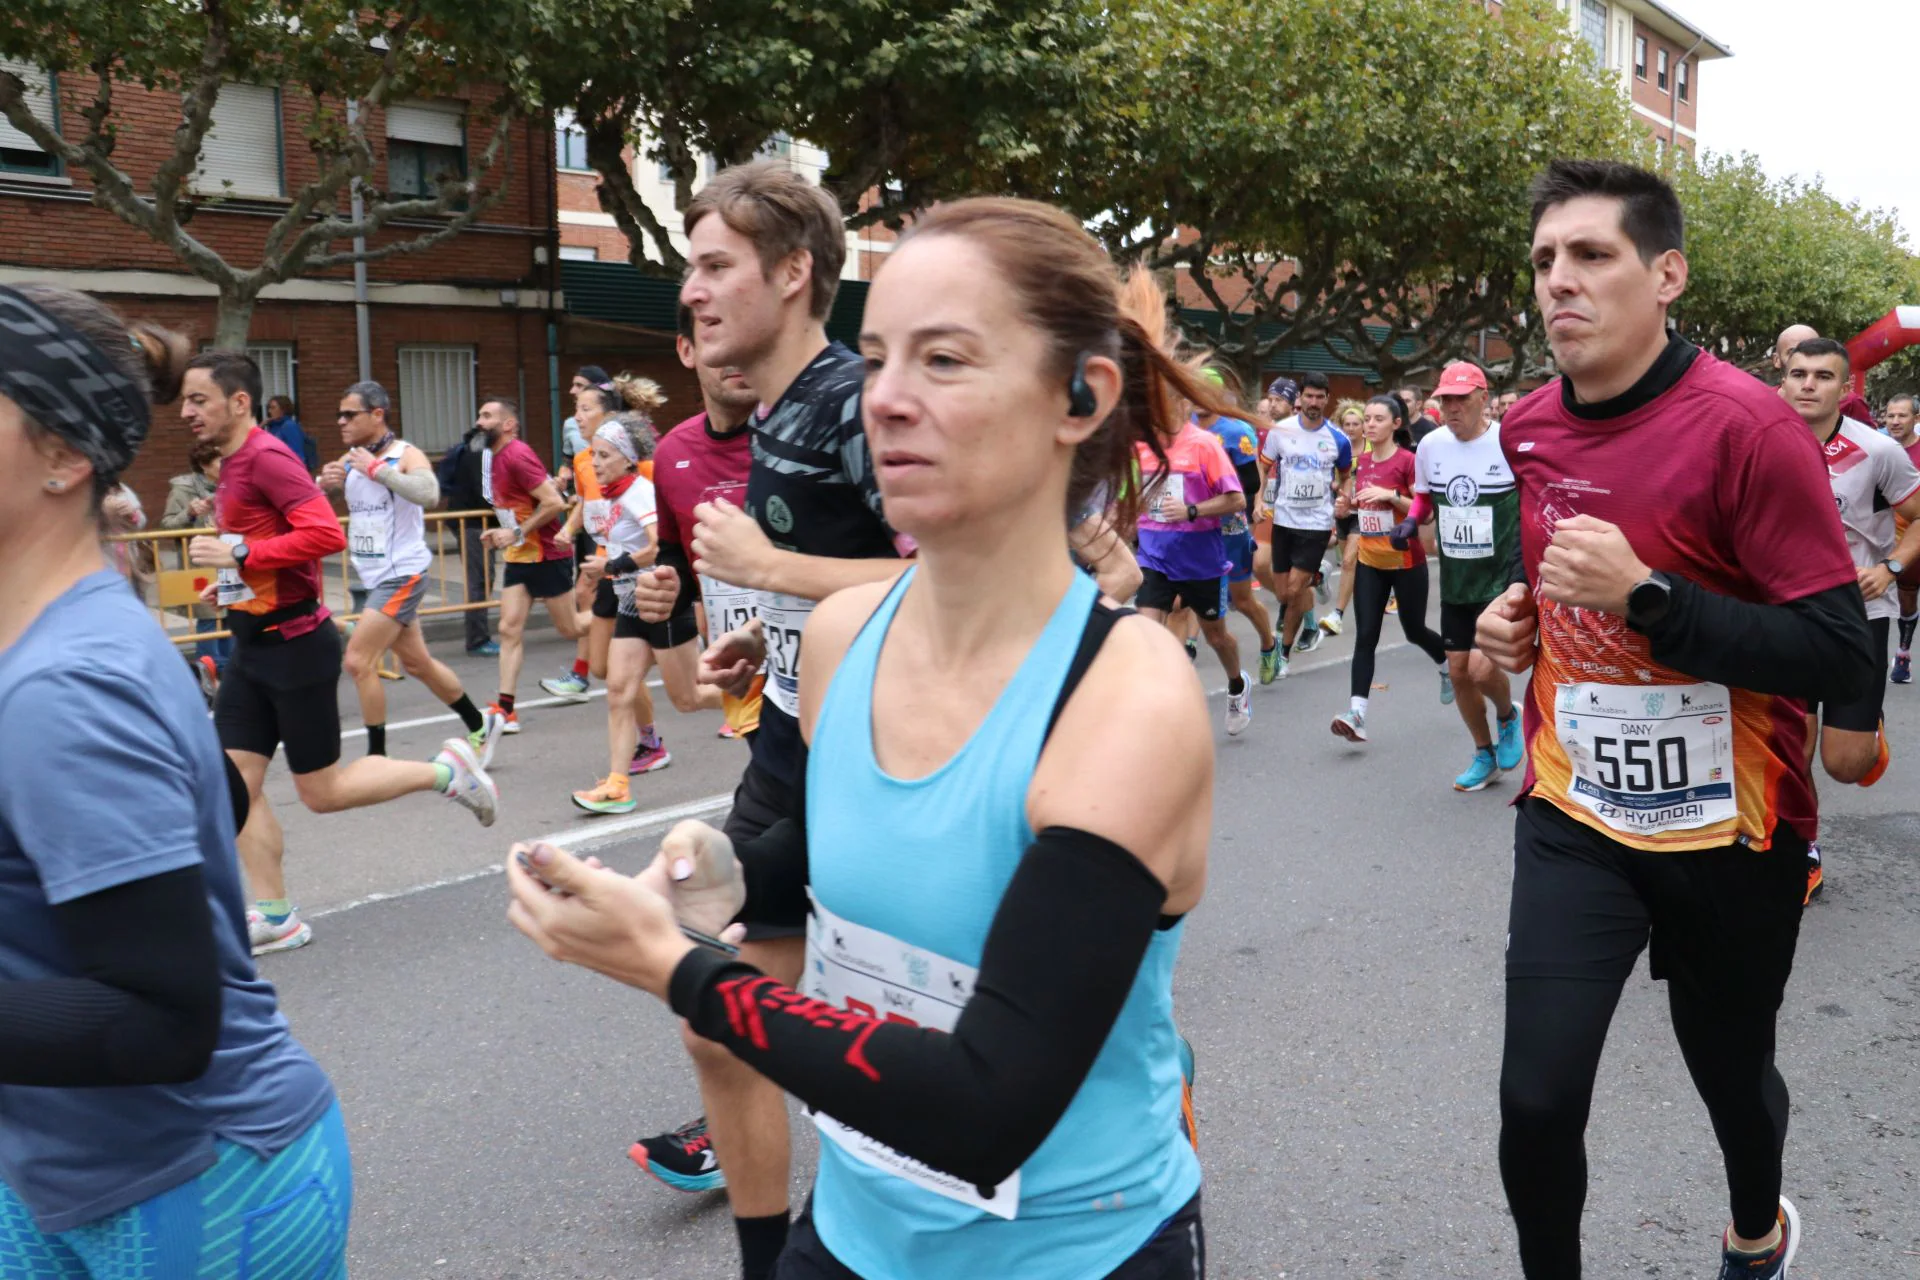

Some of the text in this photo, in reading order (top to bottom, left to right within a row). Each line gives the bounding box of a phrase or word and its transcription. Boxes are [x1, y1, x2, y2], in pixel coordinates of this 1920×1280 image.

[1294, 485, 1314, 497] 437
[1362, 516, 1382, 532] 861
[1453, 525, 1473, 543] 411
[1621, 723, 1653, 735] DANY
[1594, 735, 1689, 792] 550
[1625, 803, 1703, 825] HYUNDAI
